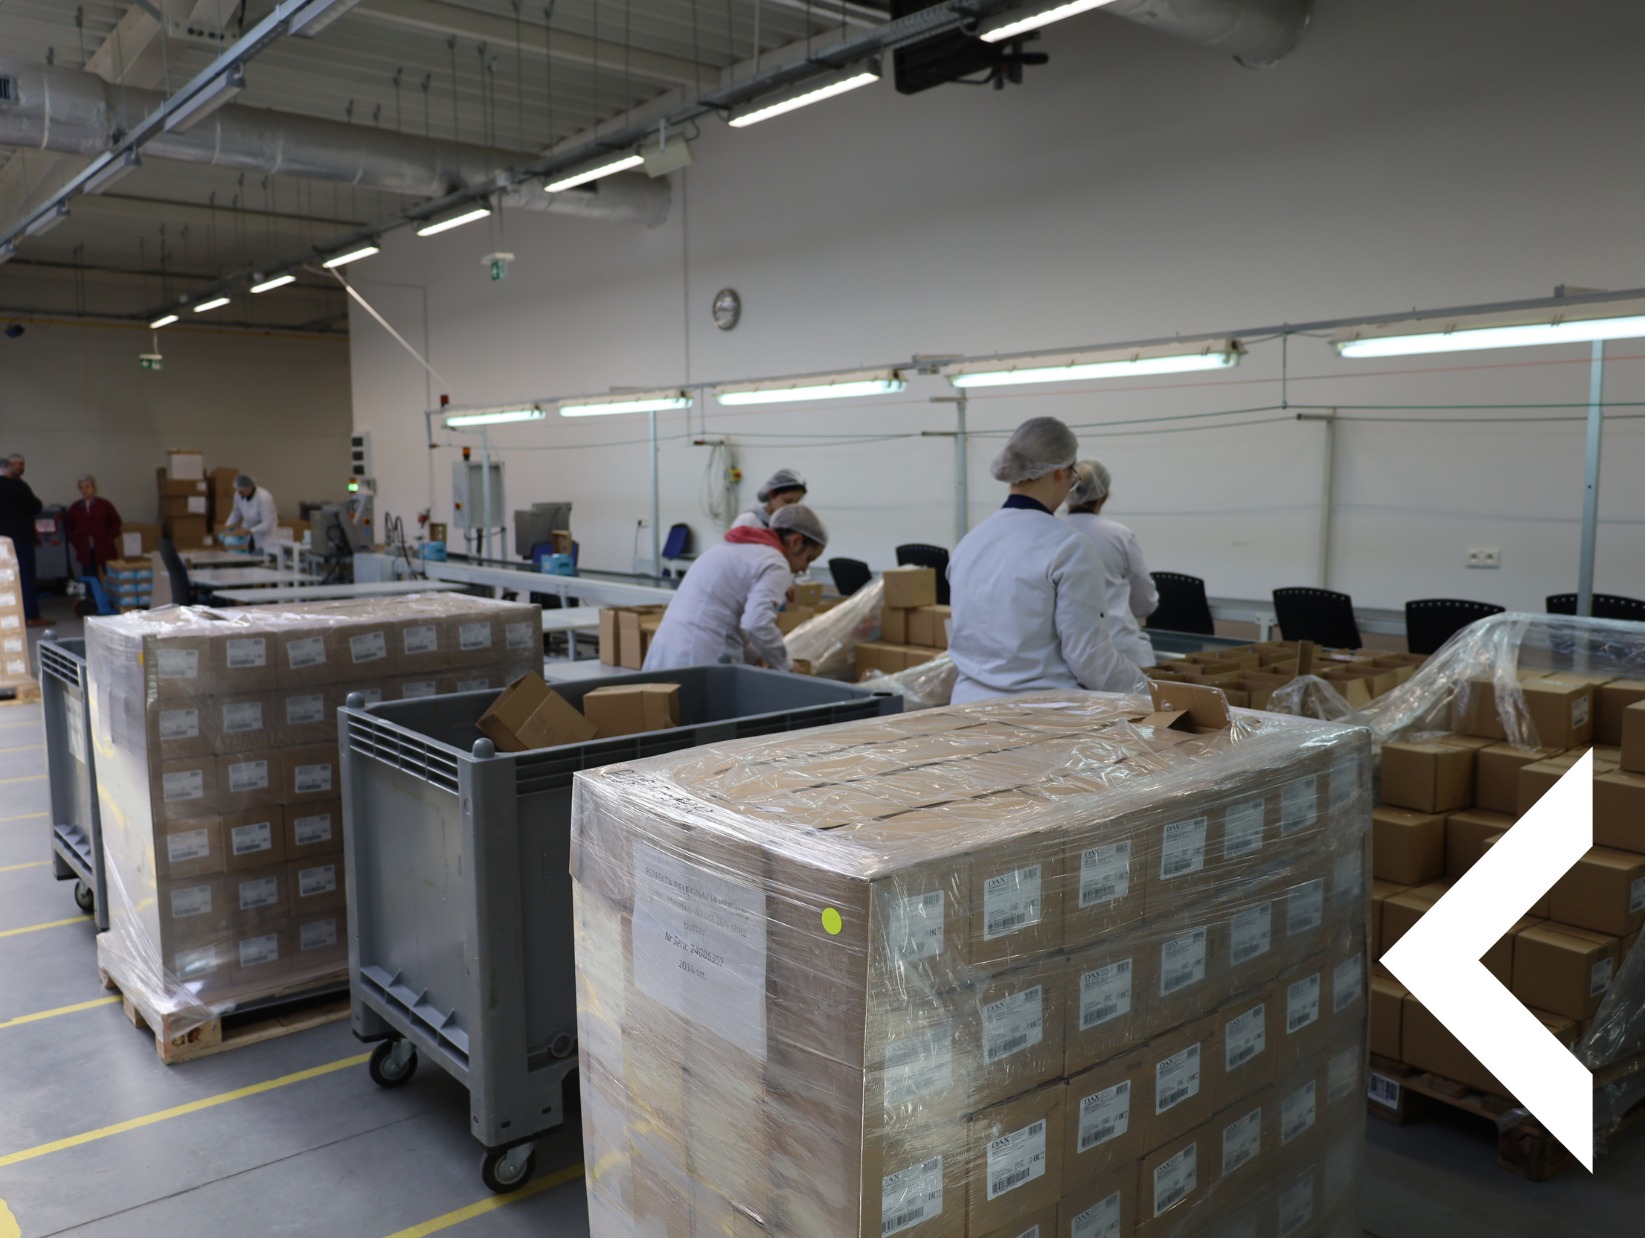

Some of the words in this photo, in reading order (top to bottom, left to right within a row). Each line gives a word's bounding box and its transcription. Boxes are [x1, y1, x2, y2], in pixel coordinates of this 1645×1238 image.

[1085, 848, 1100, 857] DAX
[988, 876, 1006, 887] DAX
[665, 932, 673, 943] Nr
[678, 959, 695, 974] 2016
[1085, 970, 1100, 981] DAX
[987, 999, 1007, 1012] DAX
[1085, 1094, 1101, 1105] DAX
[992, 1135, 1010, 1149] DAX
